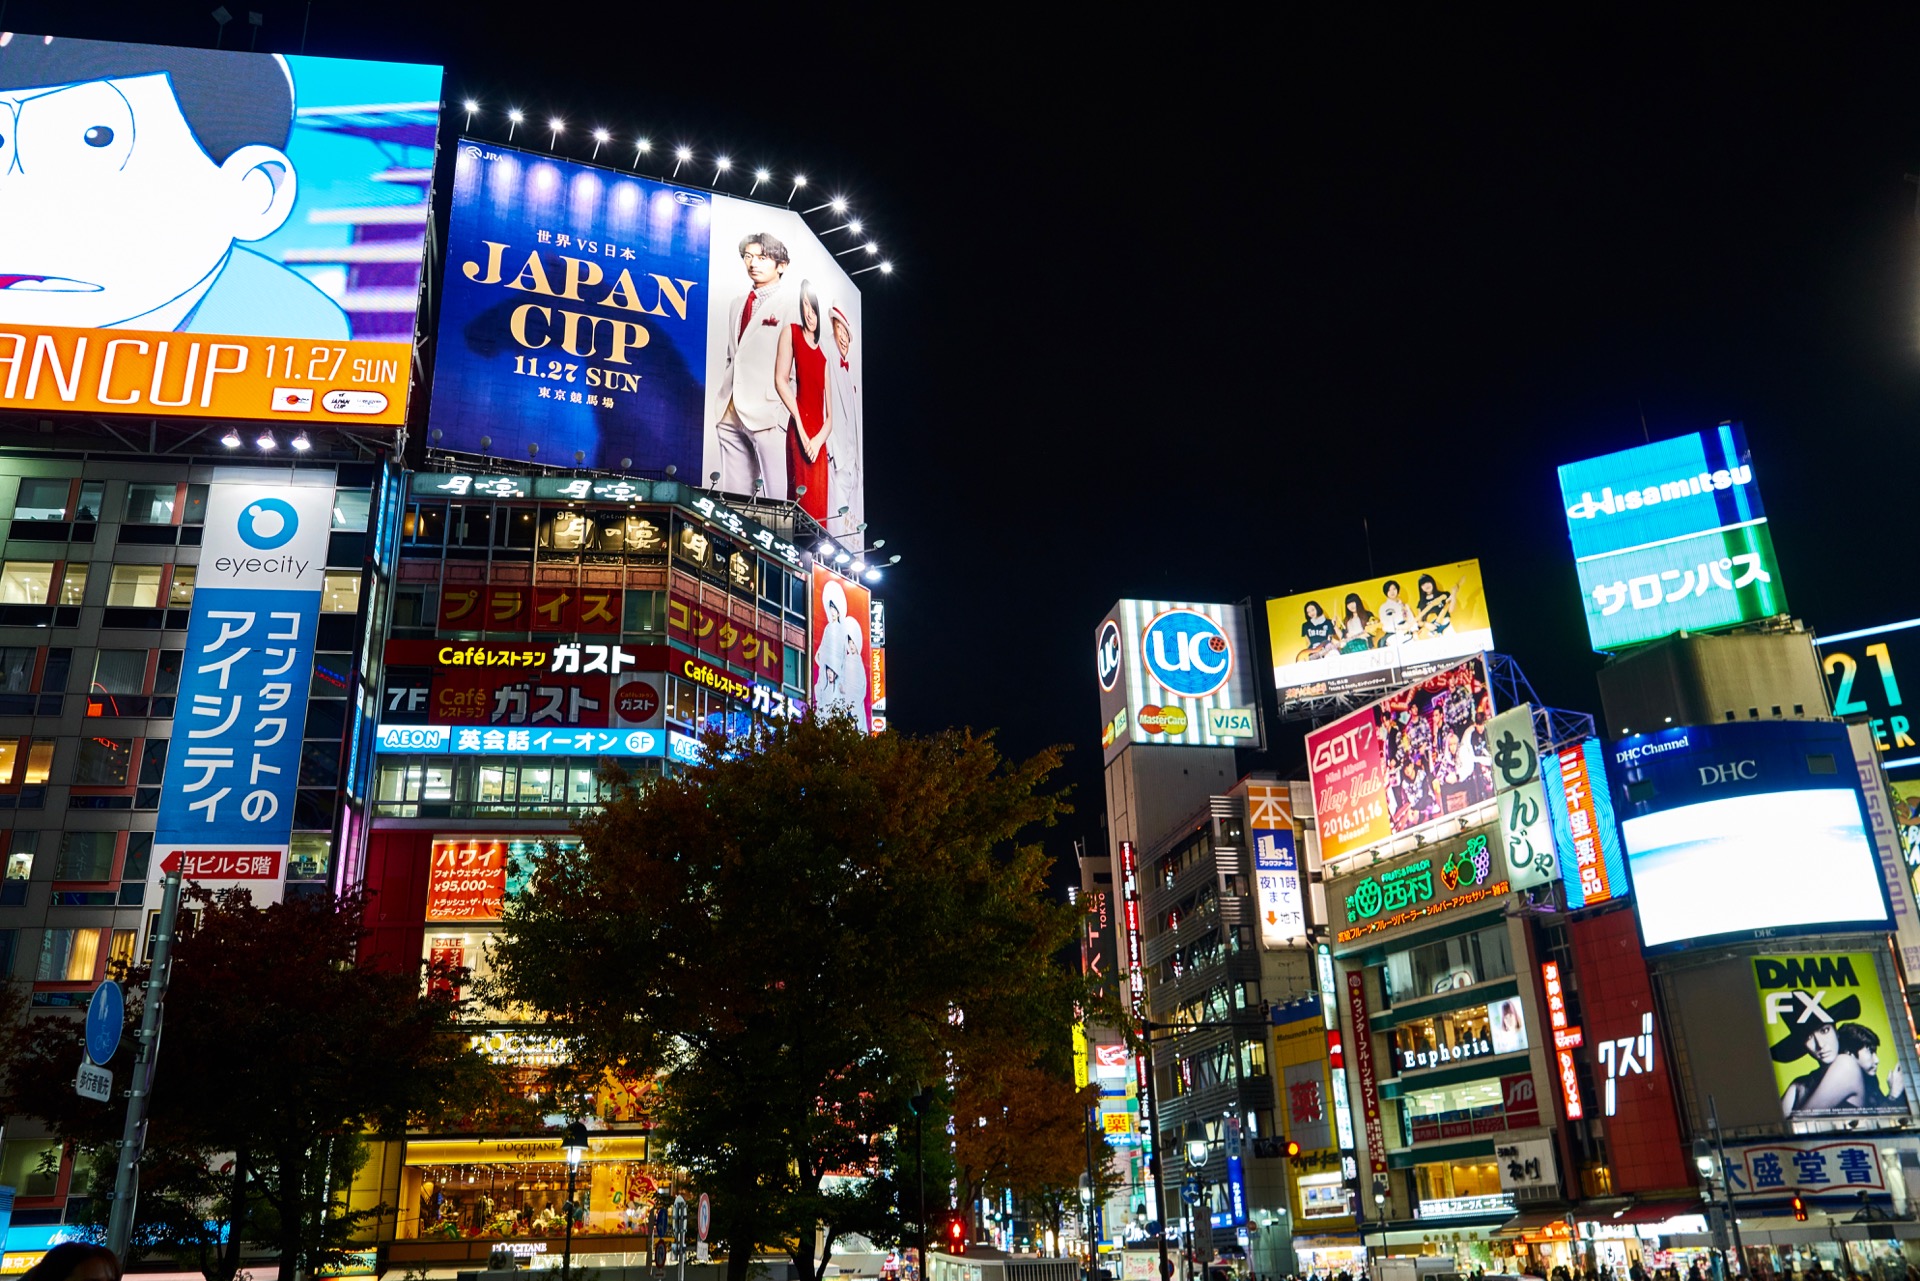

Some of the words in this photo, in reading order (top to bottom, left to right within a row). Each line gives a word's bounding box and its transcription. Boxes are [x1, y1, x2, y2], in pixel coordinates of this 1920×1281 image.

[483, 151, 503, 163] JRA
[536, 229, 572, 249] 世界
[577, 238, 599, 254] VS
[604, 243, 637, 262] 日本
[462, 239, 698, 321] JAPAN
[509, 303, 651, 365] CUP
[97, 338, 249, 409] CUP
[265, 344, 348, 382] 11.27
[352, 358, 398, 384] SUN
[513, 355, 578, 384] 11.27
[585, 367, 643, 394] SUN
[538, 386, 615, 410] 東京競馬場
[1566, 464, 1753, 520] Hisamitsu
[556, 511, 575, 520] 9F
[215, 554, 309, 580] eyecity
[1592, 552, 1771, 617] サロンパス
[444, 590, 616, 624] プライス
[669, 599, 778, 669] コンタクト
[551, 643, 636, 675] ガスト
[1152, 630, 1226, 675] UC
[1823, 642, 1903, 716] 21
[387, 687, 429, 711] 7F
[439, 687, 487, 706] Café
[491, 684, 599, 725] ガスト
[620, 699, 655, 711] ガスト
[752, 684, 802, 719] ガスト
[183, 610, 256, 823] アイシティ
[241, 611, 302, 823] コンタクトの
[439, 706, 486, 719] レストラン
[1139, 714, 1187, 727] MasterCard
[1214, 715, 1251, 730] VISA
[384, 729, 442, 750] AEON
[457, 728, 619, 753] 英会話イーオン
[629, 732, 653, 750] 6F
[1312, 721, 1374, 774] GOT7
[1616, 747, 1641, 764] DHC
[1641, 736, 1690, 758] Channel
[1342, 759, 1367, 778] Album
[1698, 760, 1759, 786] DHC
[1323, 799, 1383, 838] 2016.11.16
[1494, 729, 1555, 877] もんじゃ
[1560, 752, 1603, 896] 三千里薬品
[1857, 751, 1893, 837] Taisei
[1876, 837, 1909, 917] neon
[177, 856, 272, 875] 当ビル5階
[434, 868, 501, 878] フォトウェディング
[436, 848, 497, 867] ハワイ
[1260, 876, 1297, 890] 夜11時
[1383, 870, 1434, 911] 西村
[1098, 893, 1107, 929] TOKYO
[435, 938, 462, 947] SALE
[1753, 928, 1777, 939] DHC
[1754, 955, 1861, 990] DMM
[1765, 990, 1835, 1025] FX
[1352, 997, 1376, 1109] ウィンターフルーツギフト
[1404, 1038, 1490, 1069] Euphoria
[1290, 1080, 1324, 1124] 薬
[1507, 1078, 1534, 1107] JTB
[1106, 1113, 1127, 1132] 薬
[1443, 1123, 1470, 1137] 海外旅行
[496, 1141, 557, 1153] L'OCCITANE
[516, 1151, 537, 1161] Café
